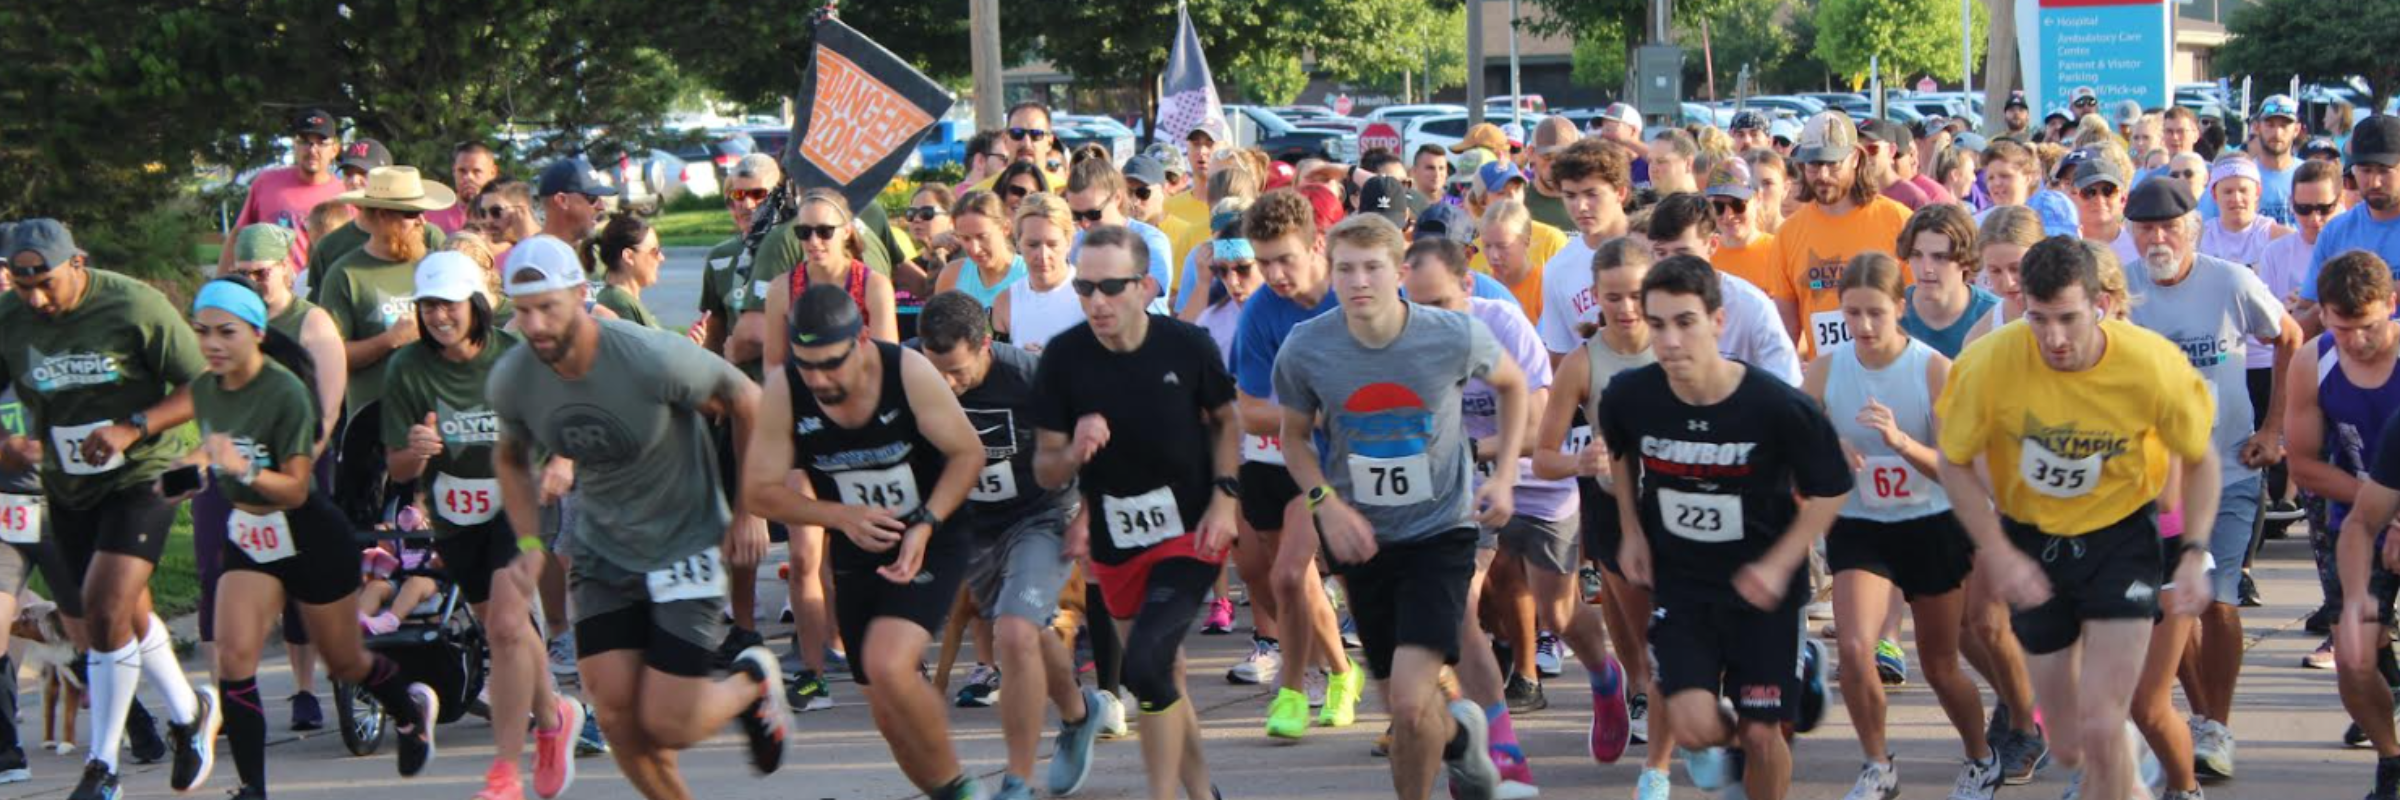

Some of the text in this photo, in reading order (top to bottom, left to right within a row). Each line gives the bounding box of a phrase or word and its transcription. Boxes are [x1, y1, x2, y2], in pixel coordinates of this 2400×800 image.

[2058, 15, 2098, 27] Hospital
[2058, 32, 2142, 44] Ambulatory Care
[2058, 46, 2090, 56] Center
[2058, 59, 2142, 70] Patient & Visitor
[2058, 72, 2099, 83] Parking
[818, 62, 914, 148] DANGER
[807, 102, 888, 177] ZONE
[33, 357, 117, 381] OLYMPIC
[1641, 436, 1757, 466] COWBOY
[1369, 467, 1409, 495] 76
[1874, 467, 1910, 497] 62
[2031, 459, 2087, 489] 355
[446, 489, 490, 514] 435
[853, 481, 904, 508] 345
[1117, 507, 1166, 535] 346
[1675, 503, 1722, 531] 223
[238, 522, 279, 551] 240
